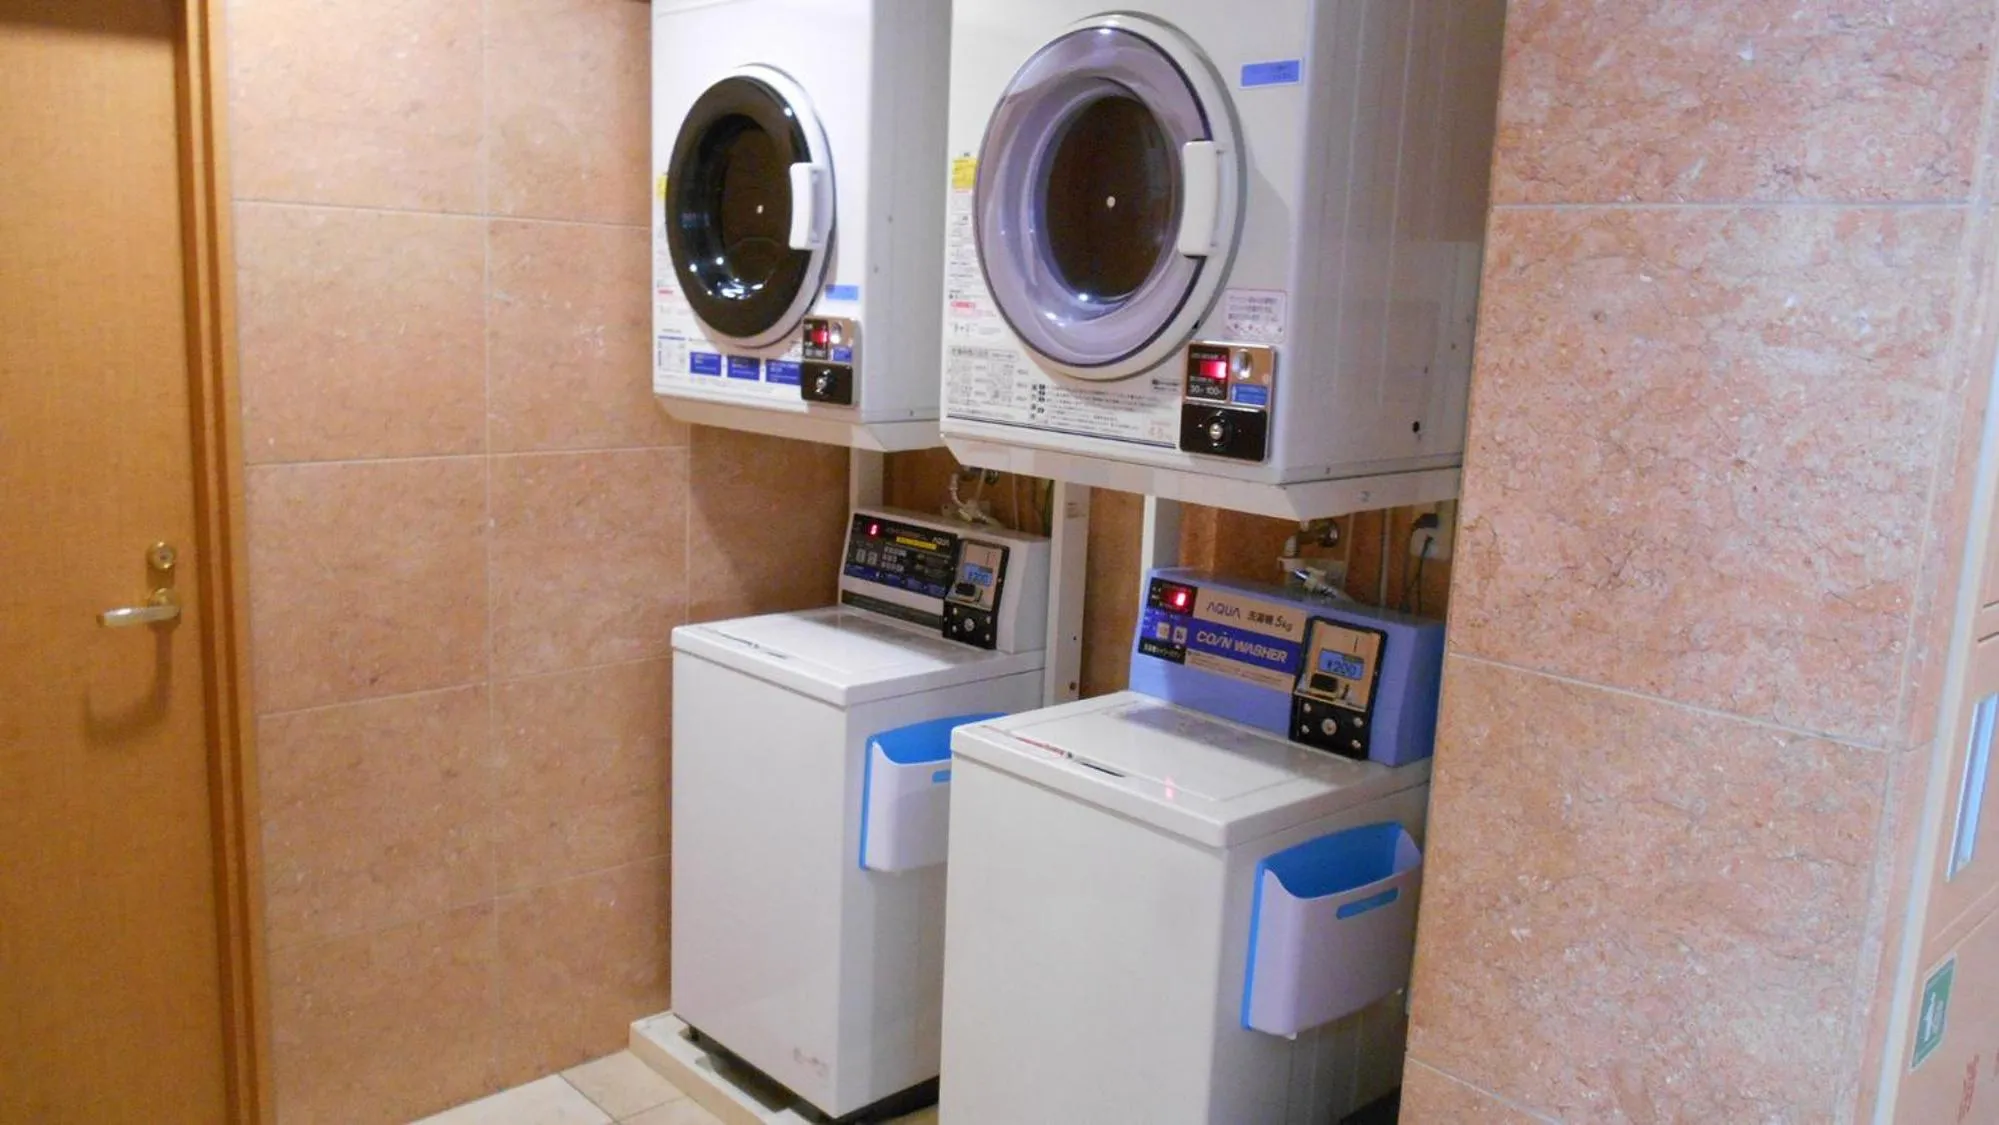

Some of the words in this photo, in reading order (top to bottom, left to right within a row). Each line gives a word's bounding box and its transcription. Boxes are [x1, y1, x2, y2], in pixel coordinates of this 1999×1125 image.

[1206, 602, 1241, 619] AQUA
[1196, 631, 1233, 649] COIN
[1233, 640, 1288, 663] WASHER
